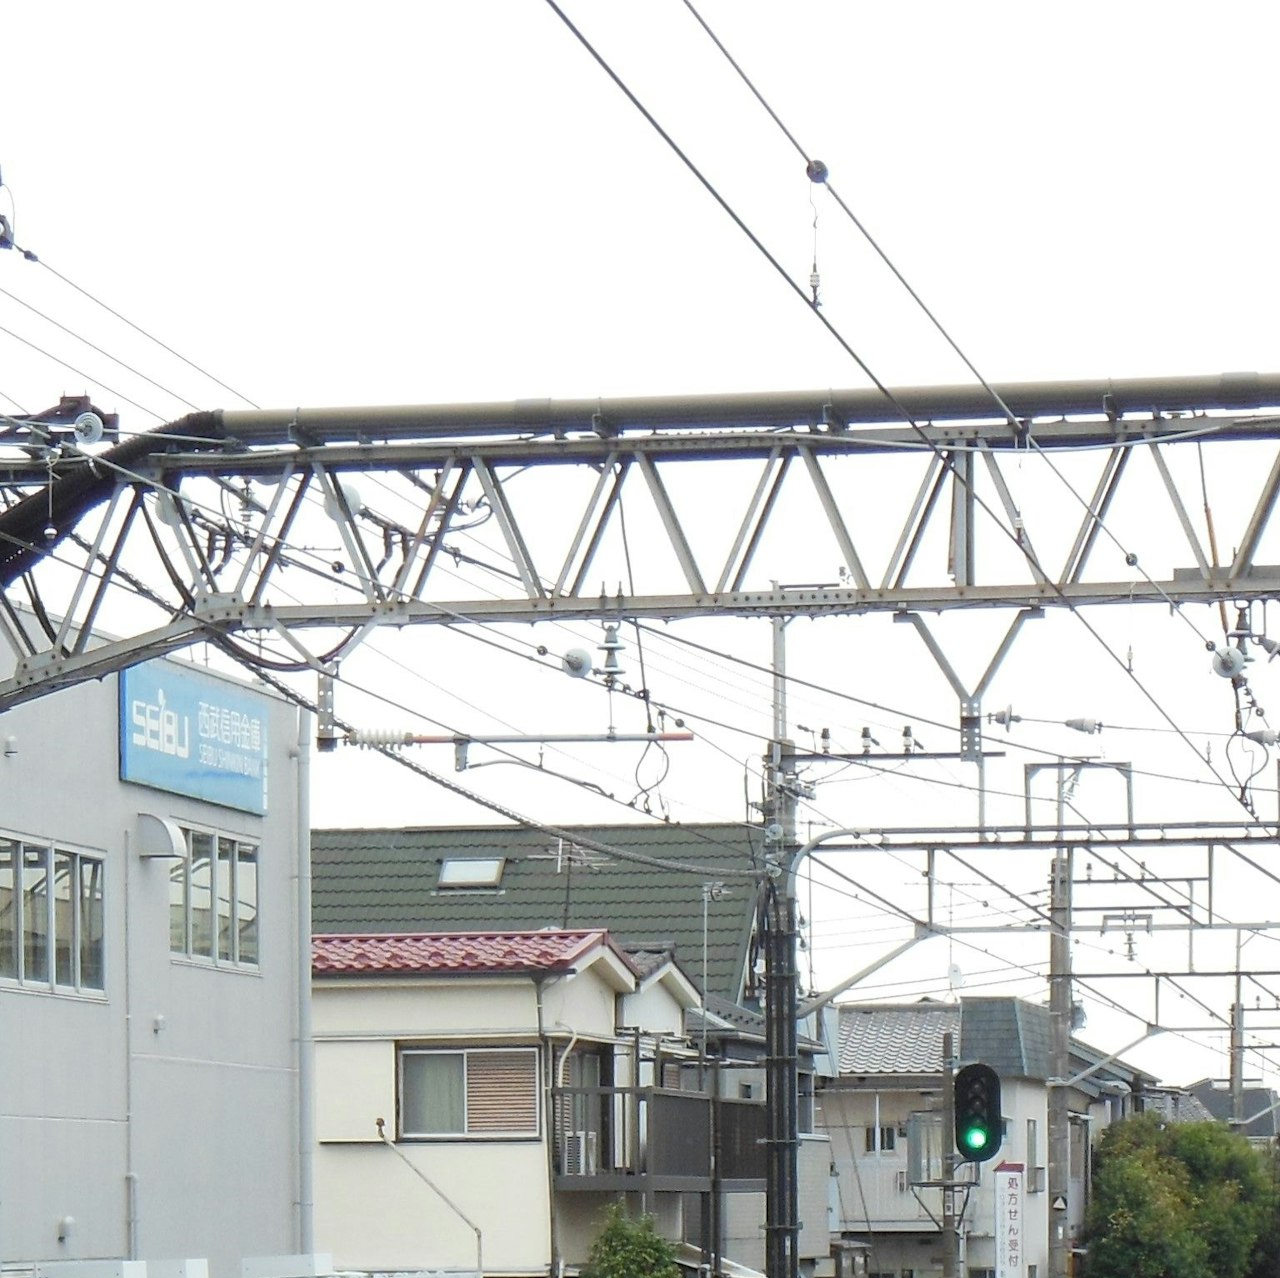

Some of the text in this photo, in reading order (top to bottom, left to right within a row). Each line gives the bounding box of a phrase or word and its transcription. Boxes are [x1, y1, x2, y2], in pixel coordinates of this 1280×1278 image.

[198, 701, 261, 752] 西武信用金庫
[1007, 1177, 1019, 1268] 処方せん受付
